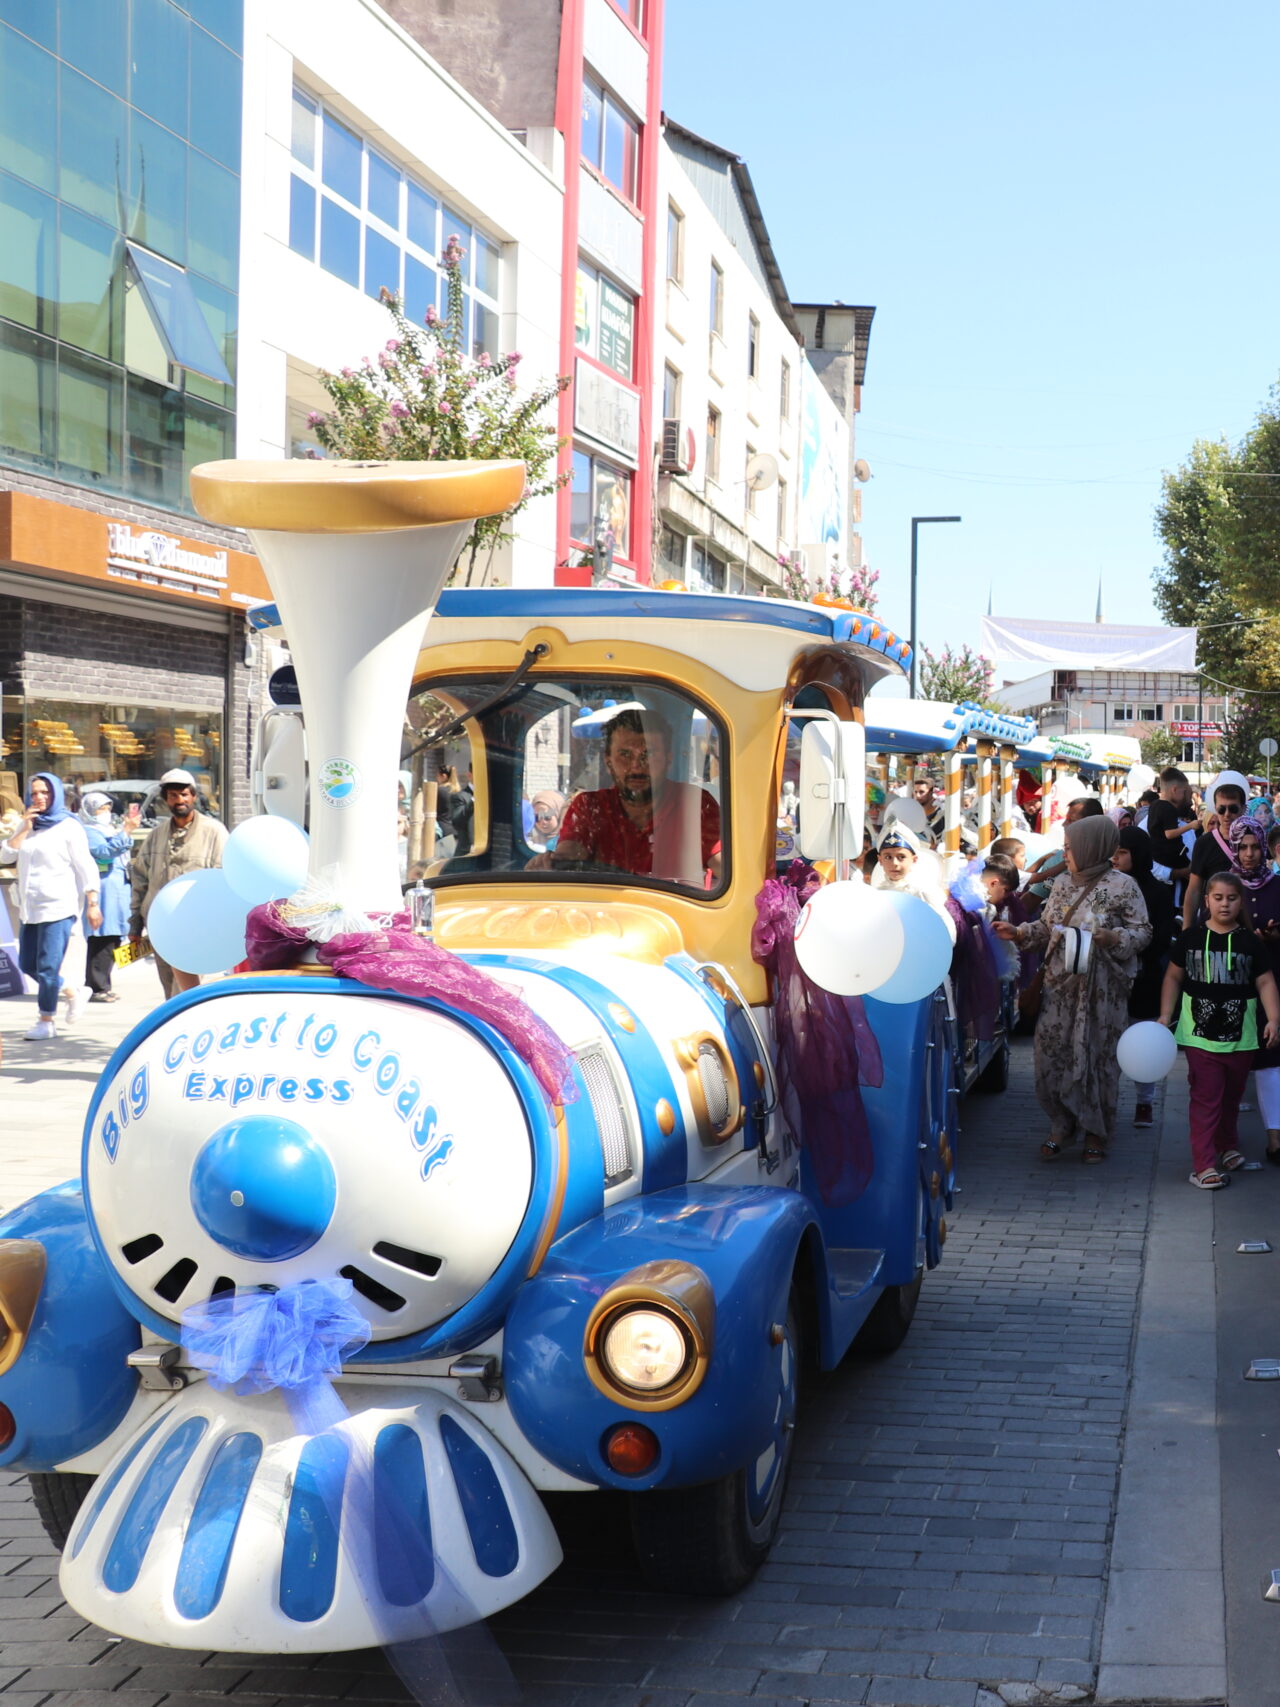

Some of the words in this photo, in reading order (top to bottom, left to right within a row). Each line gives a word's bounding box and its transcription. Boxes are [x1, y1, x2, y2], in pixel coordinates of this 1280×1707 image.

[102, 1043, 149, 1163] Big
[164, 1010, 289, 1073] Coast
[296, 1012, 339, 1057] to
[353, 1030, 454, 1182] Coast
[183, 1071, 353, 1107] Express
